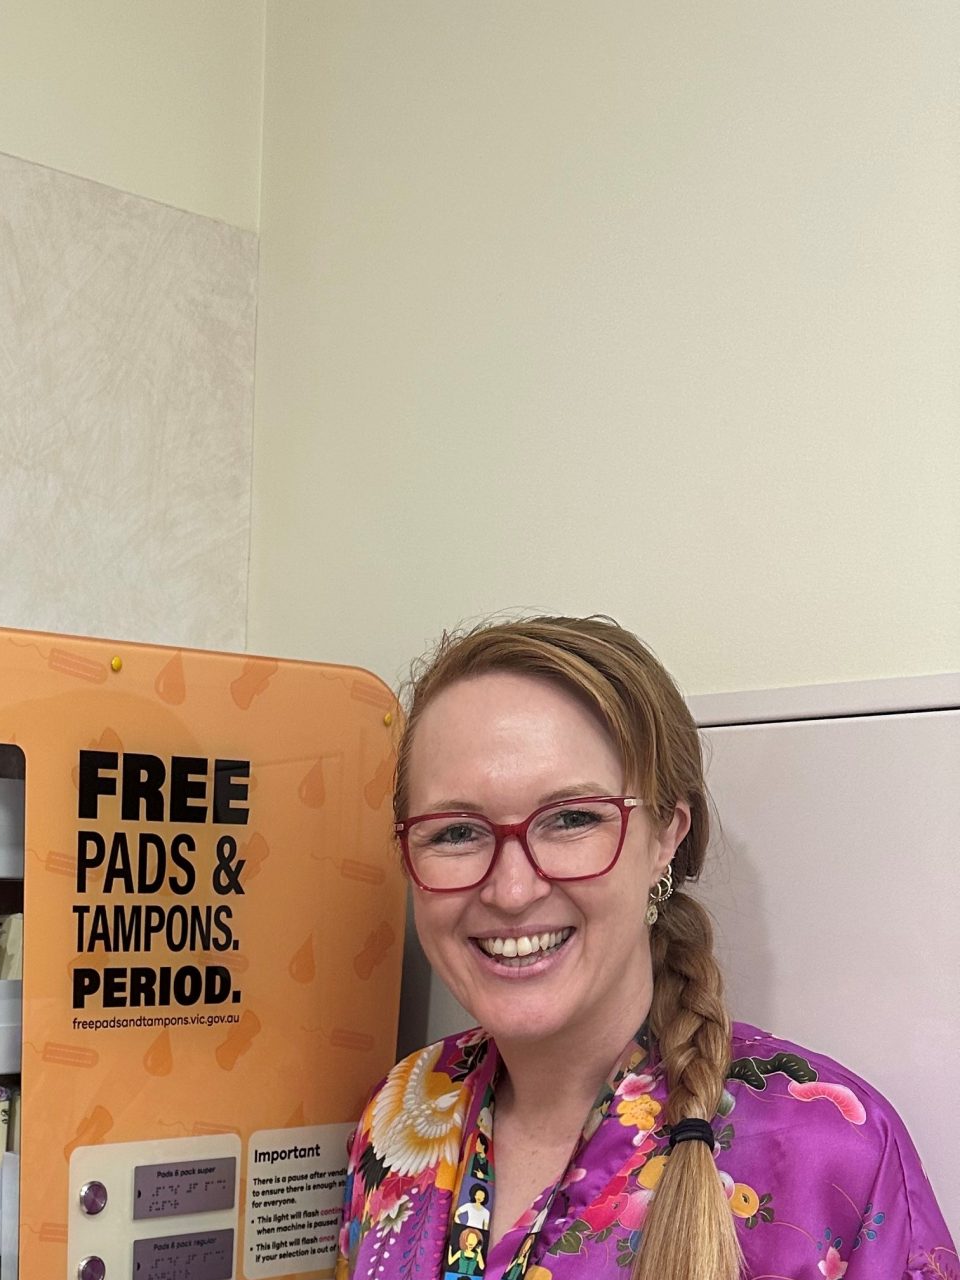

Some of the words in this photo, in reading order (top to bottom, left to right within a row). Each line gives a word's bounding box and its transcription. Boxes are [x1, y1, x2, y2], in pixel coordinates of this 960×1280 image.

[78, 749, 251, 825] FREE
[77, 831, 196, 895] PADS
[212, 835, 246, 895] &
[73, 905, 239, 952] TAMPONS.
[73, 965, 241, 1008] PERIOD.
[73, 1014, 240, 1030] freepadsandtampons.vic.gov.au
[254, 1144, 321, 1164] Important
[156, 1169, 172, 1178] Pads
[197, 1166, 215, 1174] super
[253, 1177, 274, 1186] There
[274, 1176, 281, 1184] is
[287, 1174, 308, 1183] pause
[309, 1170, 327, 1180] after
[327, 1169, 348, 1178] vendi
[261, 1187, 285, 1196] ensure
[286, 1184, 305, 1193] there
[305, 1183, 311, 1191] is
[312, 1181, 337, 1191] enough
[263, 1198, 297, 1208] everyone.
[257, 1216, 272, 1225] This
[273, 1213, 290, 1223] light
[290, 1211, 302, 1220] will
[303, 1209, 319, 1218] flash
[257, 1226, 275, 1235] when
[276, 1223, 306, 1233] machine
[307, 1221, 313, 1229] is
[313, 1218, 339, 1229] paused
[256, 1243, 271, 1251] This
[272, 1241, 288, 1251] light
[289, 1239, 301, 1247] will
[301, 1236, 318, 1245] flash
[319, 1234, 335, 1243] once
[262, 1253, 278, 1263] your
[279, 1248, 310, 1258] selection
[310, 1247, 316, 1255] is
[316, 1245, 328, 1254] out
[329, 1243, 337, 1252] of
